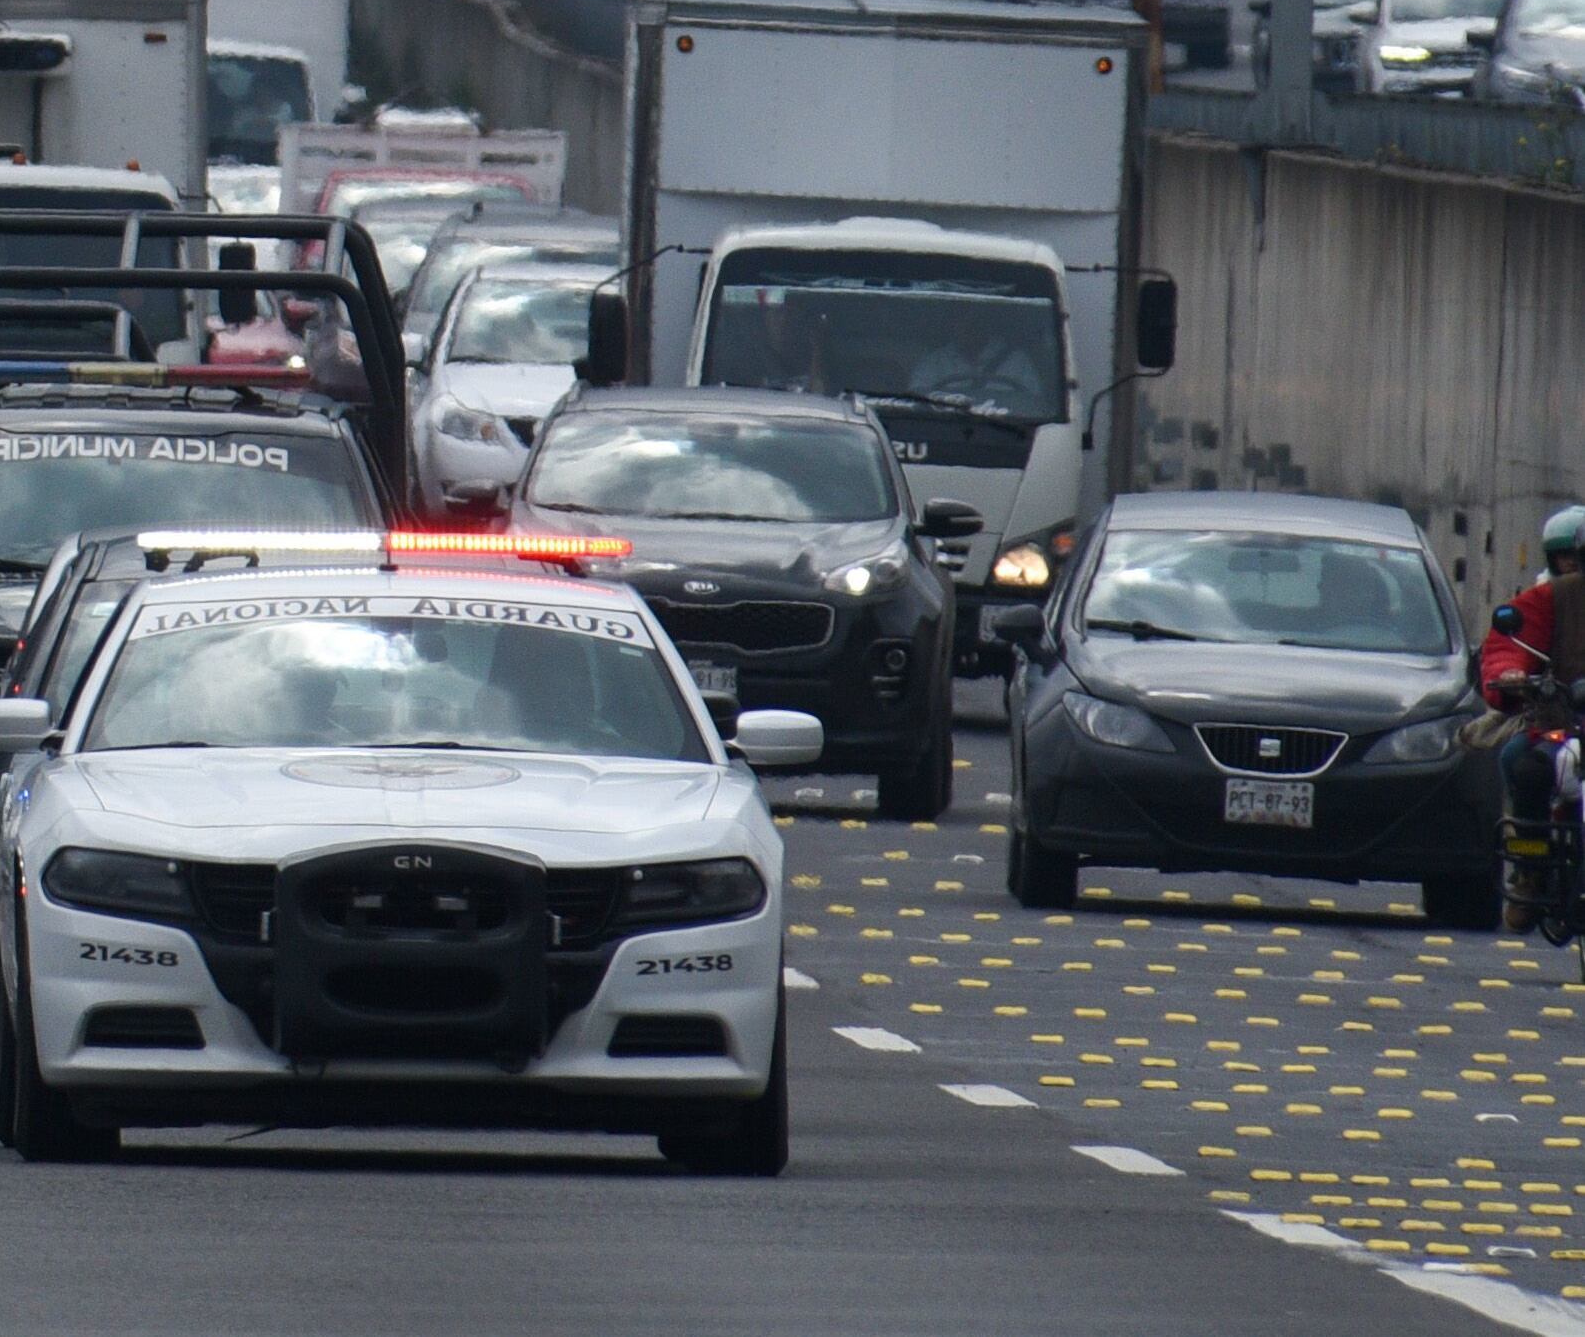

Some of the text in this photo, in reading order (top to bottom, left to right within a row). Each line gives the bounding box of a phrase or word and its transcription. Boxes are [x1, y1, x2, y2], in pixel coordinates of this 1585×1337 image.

[394, 856, 432, 869] GN
[80, 942, 179, 967] 21438
[636, 954, 733, 976] 21438
